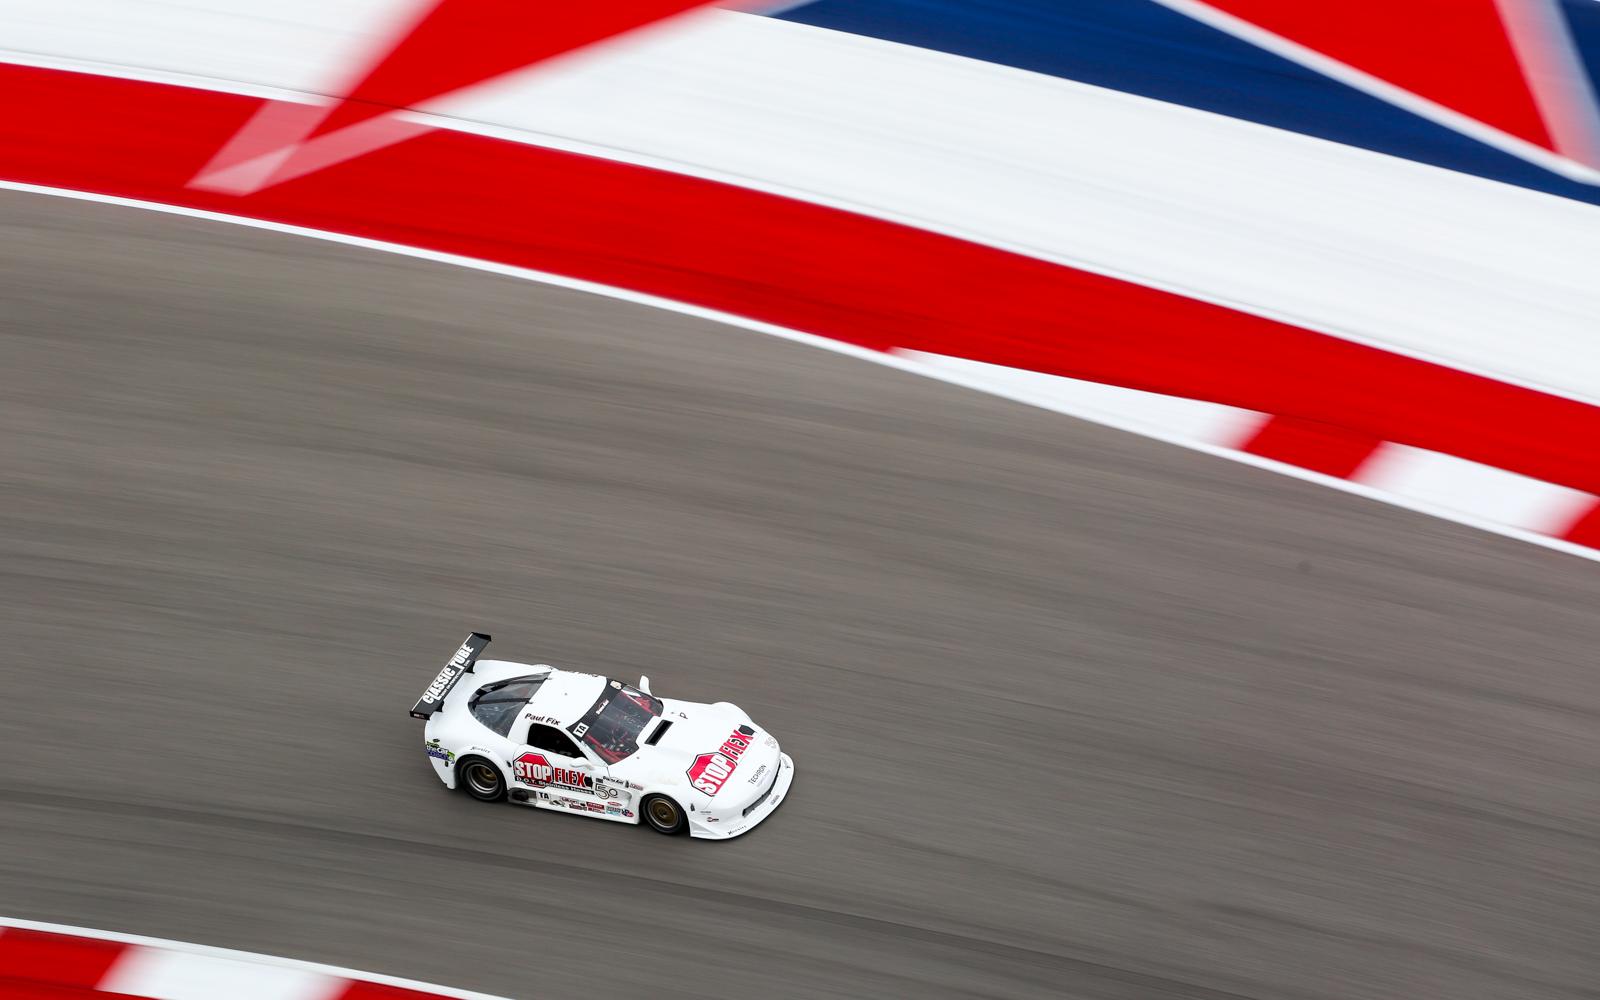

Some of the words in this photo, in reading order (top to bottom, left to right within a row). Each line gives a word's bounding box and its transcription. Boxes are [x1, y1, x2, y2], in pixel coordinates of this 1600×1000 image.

[422, 667, 456, 704] CLASSIC
[452, 643, 474, 670] TUBE
[525, 713, 545, 722] Paul
[546, 717, 560, 726] Fix
[576, 725, 586, 735] TA
[693, 754, 732, 794] STOP
[718, 729, 754, 762] FLEX
[516, 761, 551, 782] STOP
[554, 767, 587, 787] FLEX
[539, 792, 550, 800] TA
